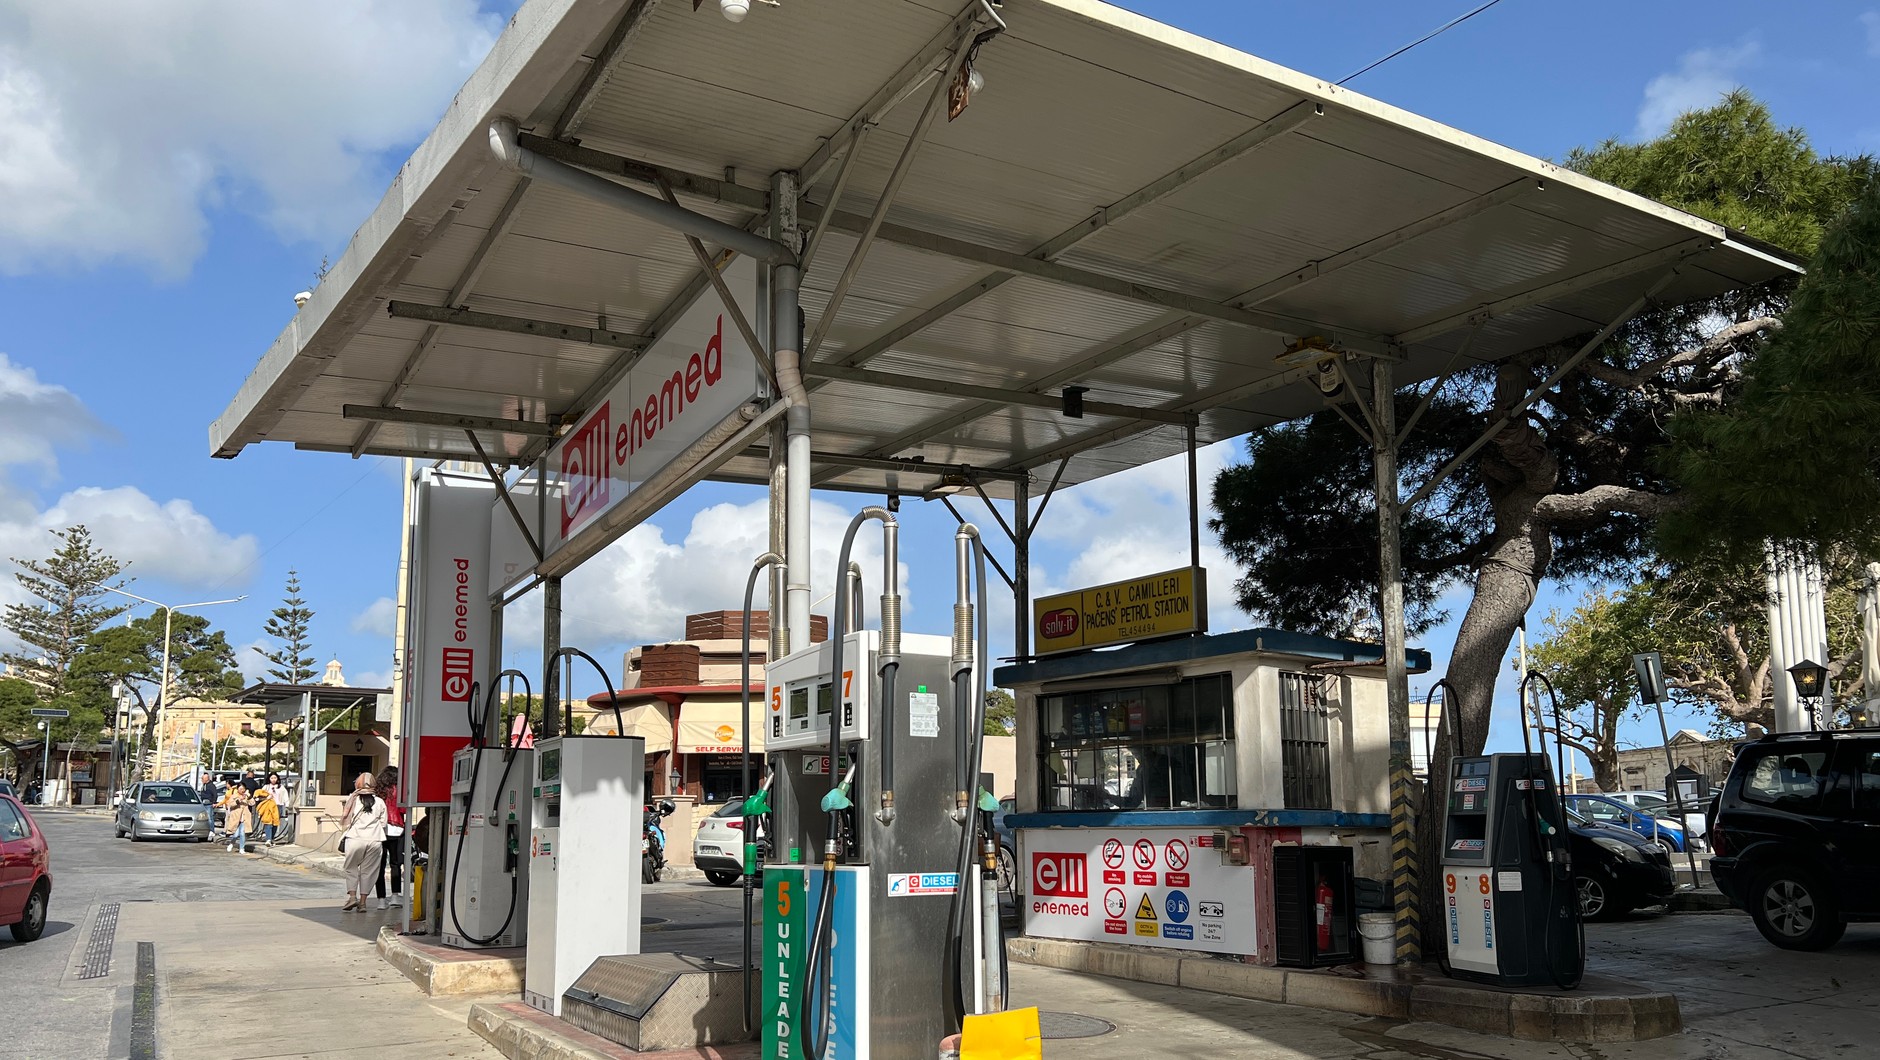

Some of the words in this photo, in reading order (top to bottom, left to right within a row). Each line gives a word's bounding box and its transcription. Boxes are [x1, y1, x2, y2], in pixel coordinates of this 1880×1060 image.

[615, 313, 723, 467] enemed
[453, 558, 470, 642] enemed
[1095, 592, 1103, 608] C.
[1105, 591, 1111, 606] &
[1114, 589, 1121, 605] V.
[1128, 577, 1180, 601] CAMILLERI
[1120, 604, 1152, 624] PETROL
[1154, 595, 1189, 618] STATION
[1045, 613, 1074, 635] solv-it
[842, 670, 853, 698] 7
[771, 686, 781, 712] 5
[1468, 779, 1485, 787] DIESEL
[532, 836, 537, 858] 3
[1446, 873, 1456, 894] 9
[1479, 873, 1490, 895] 8
[777, 881, 790, 917] 5
[1033, 901, 1089, 917] enemed
[1450, 908, 1459, 944] DIESEL
[1485, 910, 1493, 949] DIESEL
